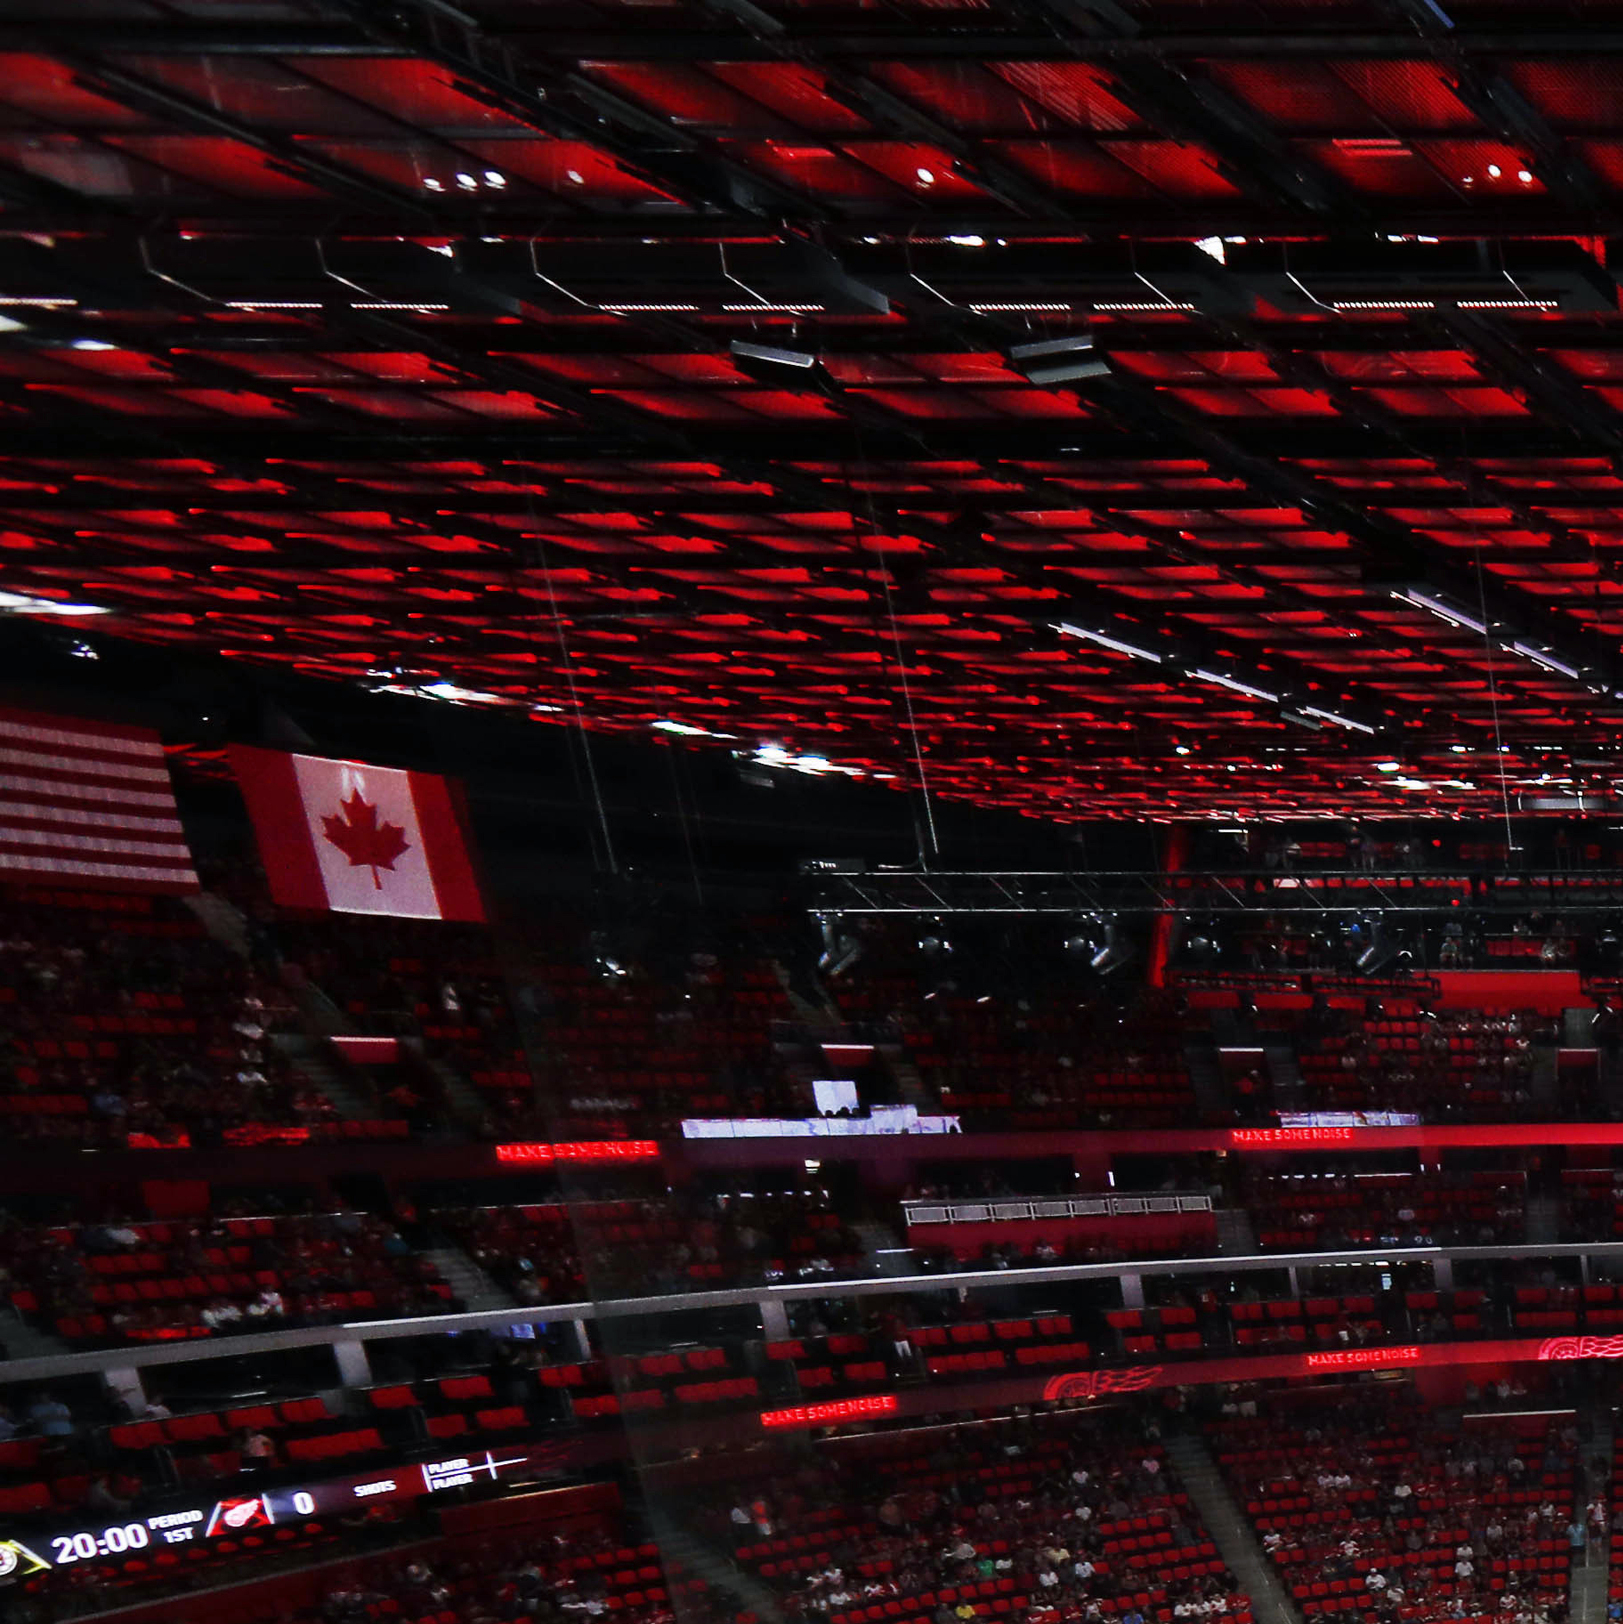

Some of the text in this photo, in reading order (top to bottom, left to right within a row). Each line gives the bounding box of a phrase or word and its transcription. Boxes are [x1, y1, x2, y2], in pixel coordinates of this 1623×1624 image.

[1233, 1130, 1271, 1142] MAKE
[1313, 1128, 1351, 1139] NOISE
[1308, 1353, 1344, 1366] MAKE
[428, 1457, 469, 1475] PLAYER
[355, 1479, 397, 1498] SHOTS
[431, 1471, 473, 1489] PLAYER
[293, 1492, 314, 1515] 0
[50, 1509, 203, 1564] 20:00 PERIOD
[164, 1527, 194, 1544] 1ST
